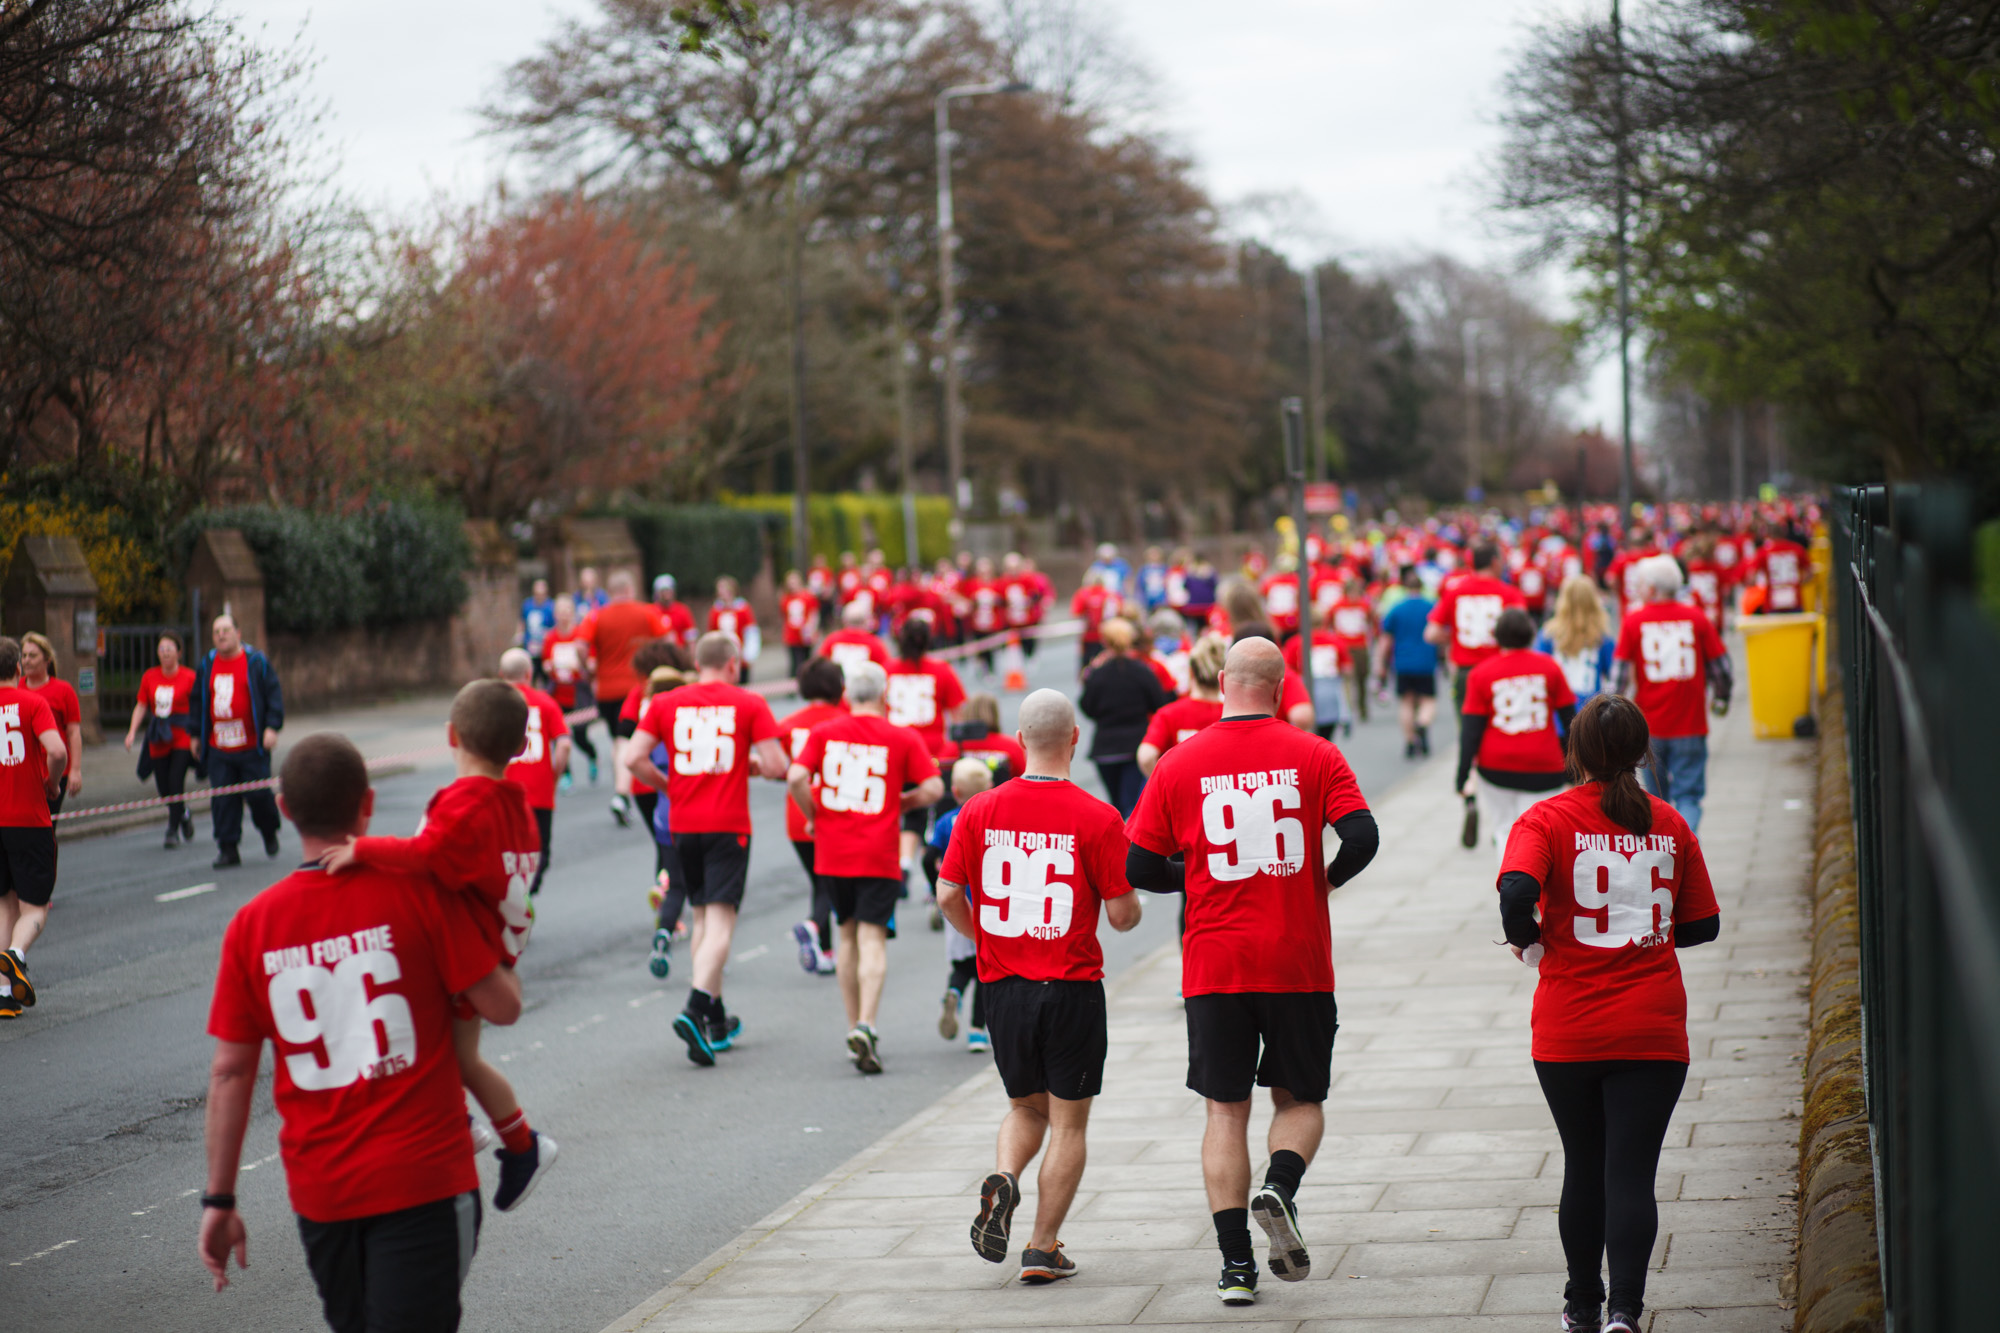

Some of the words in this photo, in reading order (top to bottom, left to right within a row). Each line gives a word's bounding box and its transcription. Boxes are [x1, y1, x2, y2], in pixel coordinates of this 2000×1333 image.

[1641, 630, 1697, 683] 96
[1492, 685, 1548, 735] 96
[0, 713, 25, 766] 6
[673, 717, 736, 776] 96
[821, 752, 888, 815] 96
[1200, 774, 1234, 795] RUN
[1237, 771, 1268, 790] FOR
[1269, 768, 1299, 786] THE
[984, 828, 1016, 847] RUN
[1018, 831, 1047, 850] FOR
[1048, 833, 1075, 852] THE
[1201, 784, 1305, 882] 96
[1575, 831, 1610, 851] RUN
[1614, 834, 1648, 853] FOR
[1648, 834, 1677, 854] THE
[979, 845, 1075, 940] 96
[1268, 862, 1297, 877] 2015
[1573, 849, 1675, 948] 96
[263, 944, 310, 975] RUN
[311, 934, 353, 966] FOR
[352, 924, 394, 955] THE
[1033, 926, 1061, 940] 2015
[268, 949, 417, 1091] 96
[366, 1053, 409, 1080] 2015
